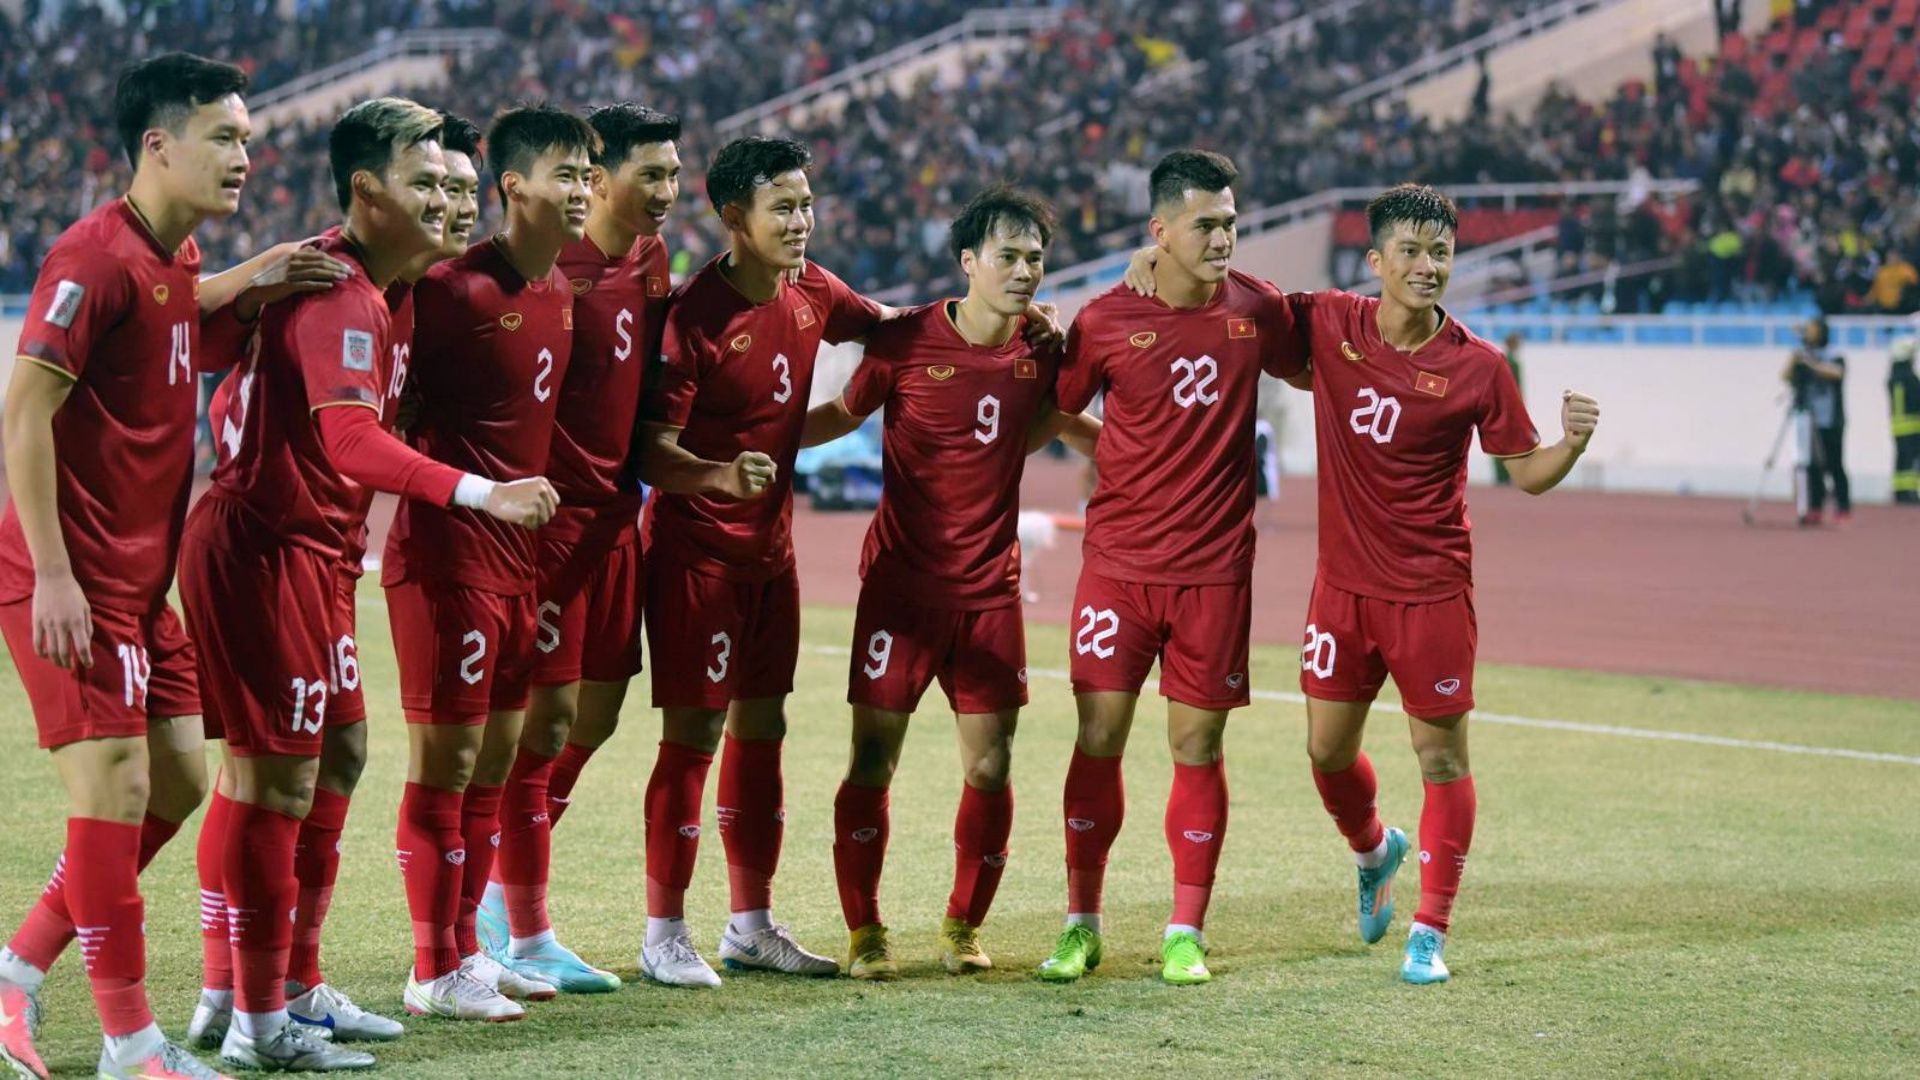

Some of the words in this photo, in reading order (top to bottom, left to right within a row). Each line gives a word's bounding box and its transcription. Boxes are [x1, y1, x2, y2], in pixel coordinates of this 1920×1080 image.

[169, 321, 191, 385] 14
[387, 342, 410, 399] 16
[533, 347, 553, 403] 2
[772, 353, 793, 403] 3
[1170, 354, 1219, 408] 22
[974, 394, 1000, 445] 9
[1349, 387, 1402, 444] 20
[460, 629, 486, 685] 2
[706, 631, 731, 683] 3
[863, 629, 894, 680] 9
[1075, 605, 1120, 659] 22
[1302, 623, 1337, 680] 20
[118, 643, 151, 711] 14
[329, 634, 359, 695] 16
[292, 677, 327, 735] 13
